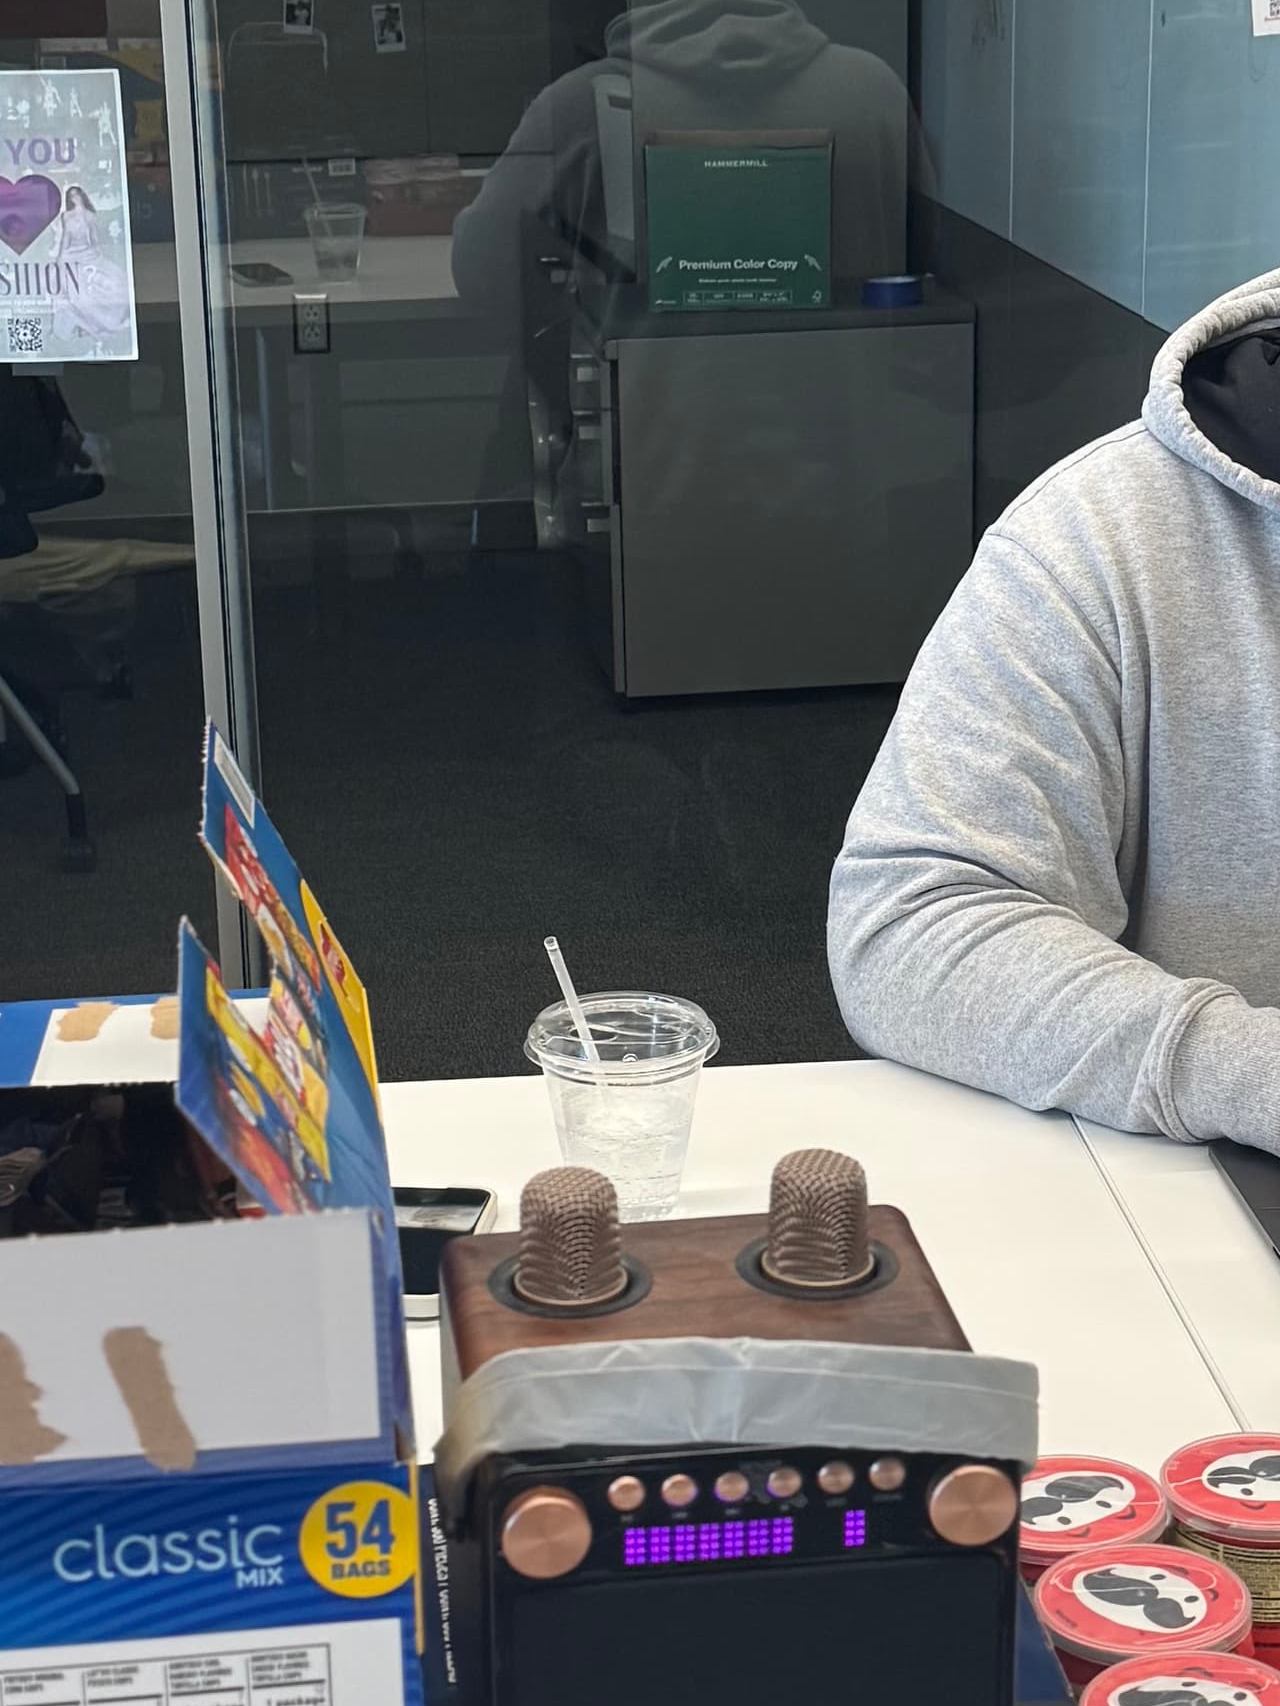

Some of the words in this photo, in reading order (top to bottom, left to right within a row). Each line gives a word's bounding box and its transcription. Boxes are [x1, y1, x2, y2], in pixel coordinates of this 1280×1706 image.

[4, 137, 77, 165] YOU
[704, 160, 768, 168] HAMMERMILL
[679, 260, 731, 270] Premium
[733, 259, 765, 270] Color
[767, 259, 798, 271] Copy
[324, 1502, 397, 1562] 54
[52, 1516, 285, 1587] classic
[234, 1566, 285, 1591] MIX
[330, 1559, 393, 1584] BAGS
